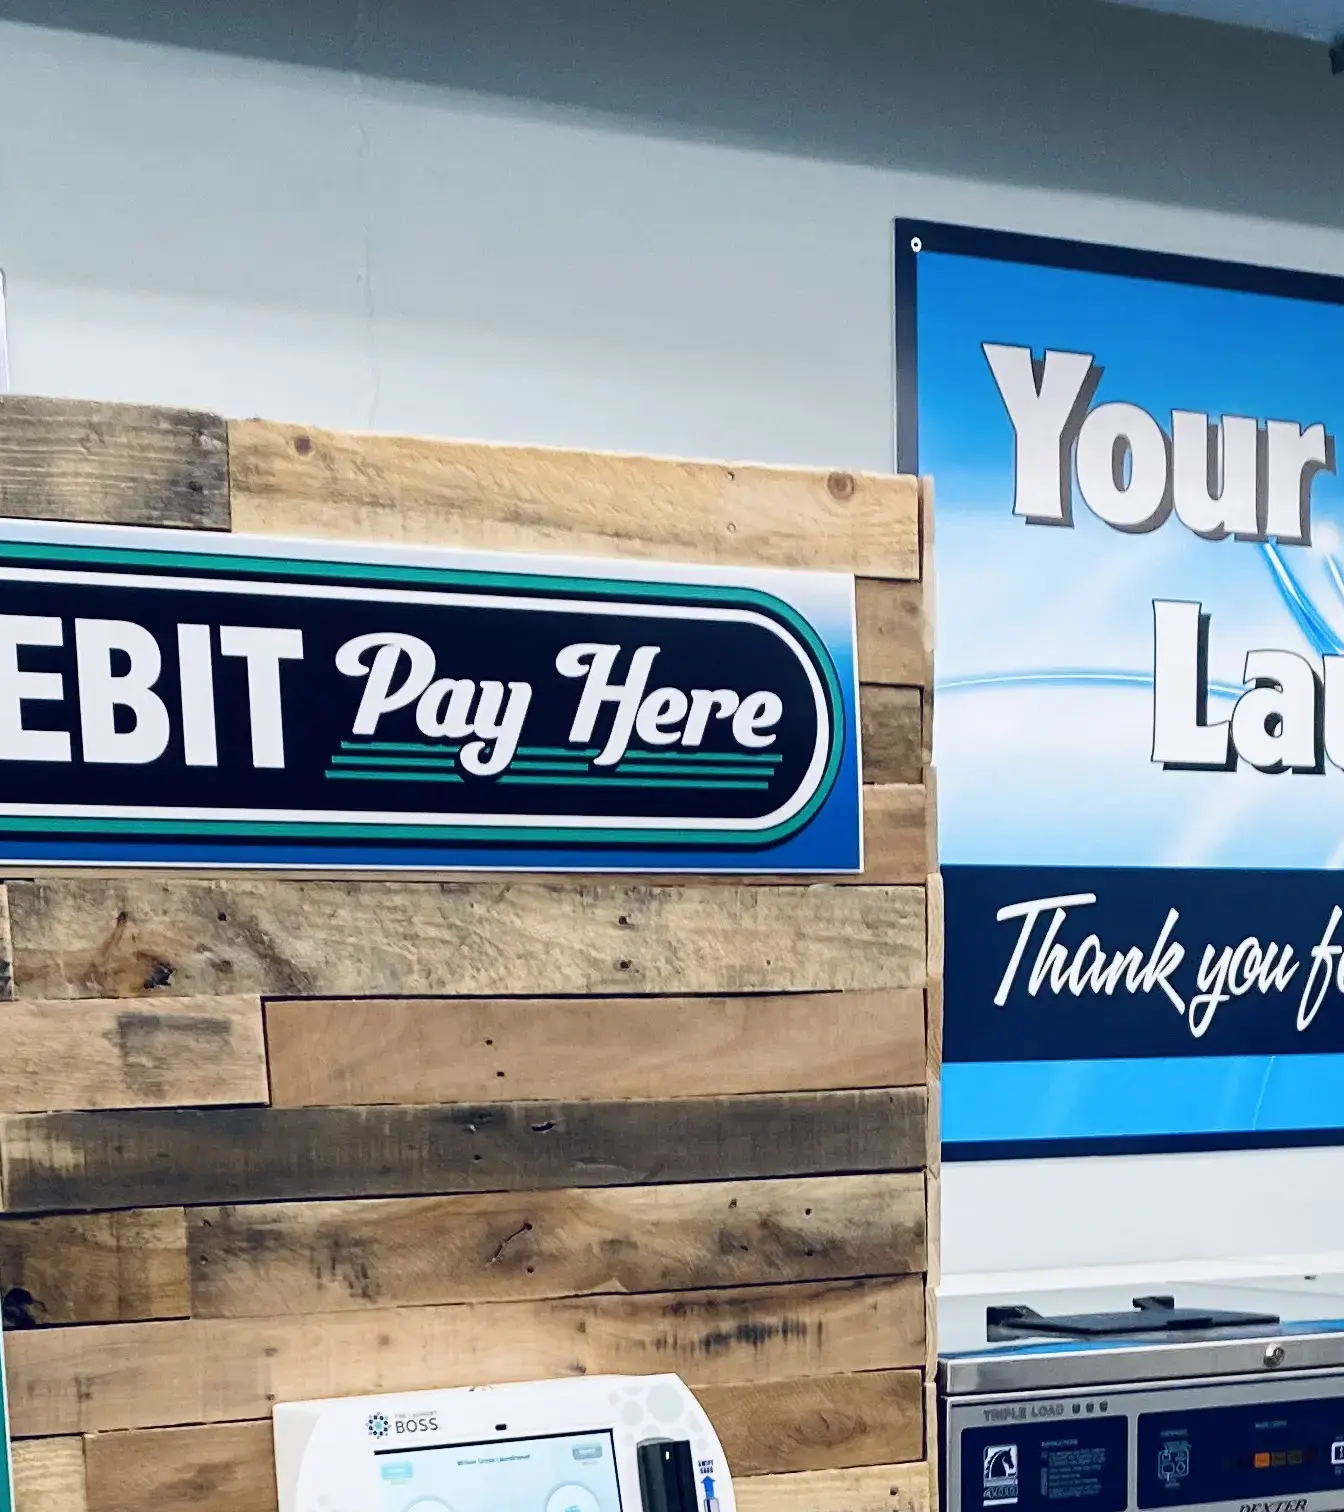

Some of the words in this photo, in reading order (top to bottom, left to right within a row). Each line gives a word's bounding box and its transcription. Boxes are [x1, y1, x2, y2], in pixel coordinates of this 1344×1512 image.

[981, 342, 1336, 546] Your
[336, 633, 532, 775] Pay
[556, 644, 782, 765] Here
[993, 892, 1186, 1015] Thank
[1188, 935, 1300, 1038] you
[396, 1418, 438, 1434] BOSS
[984, 1407, 1026, 1421] TRIPLE
[1031, 1404, 1064, 1418] LOAD
